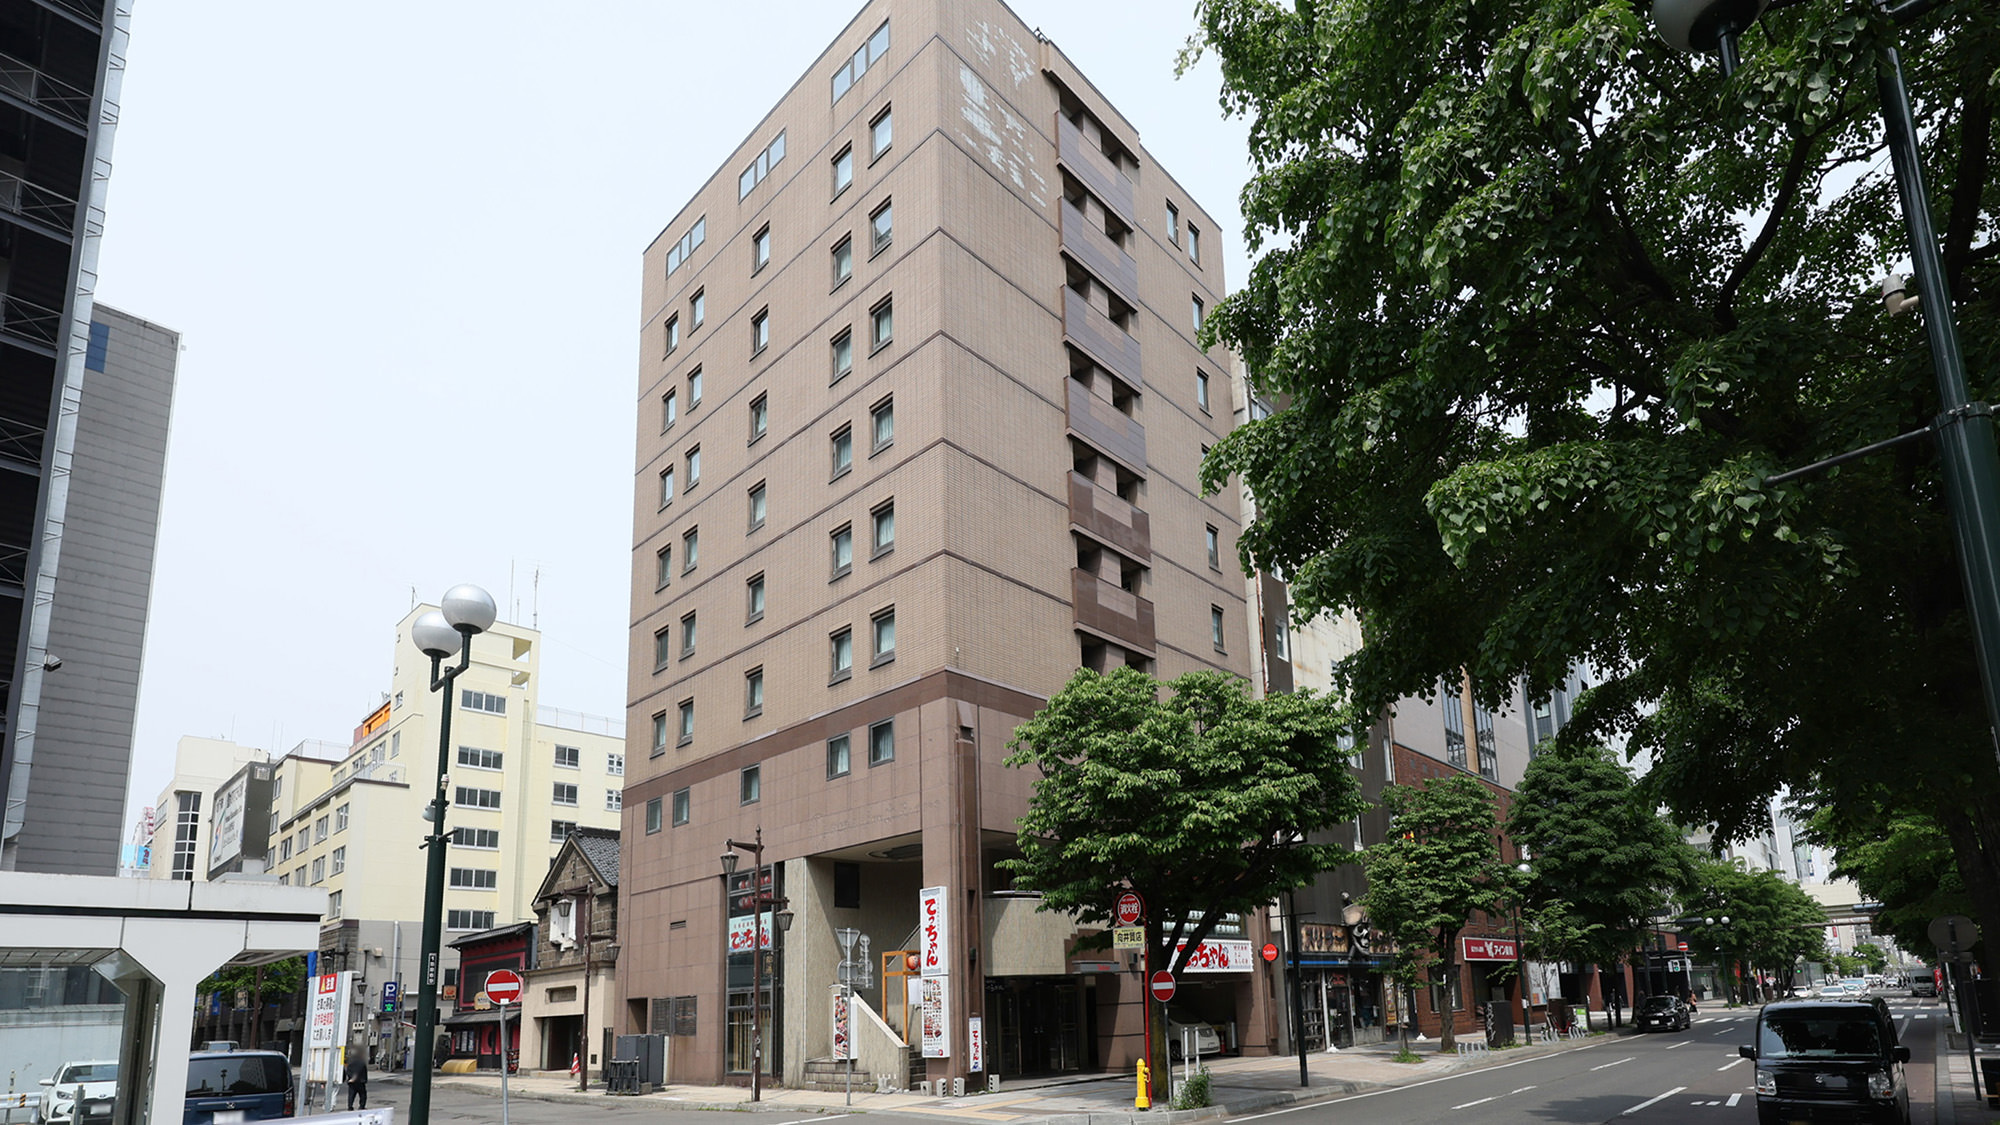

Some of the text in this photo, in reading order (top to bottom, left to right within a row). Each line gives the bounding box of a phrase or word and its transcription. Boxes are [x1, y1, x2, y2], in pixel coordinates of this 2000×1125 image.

[1120, 902, 1138, 915] 消火栓
[730, 926, 770, 950] てっちん
[924, 898, 938, 967] てっちゃん
